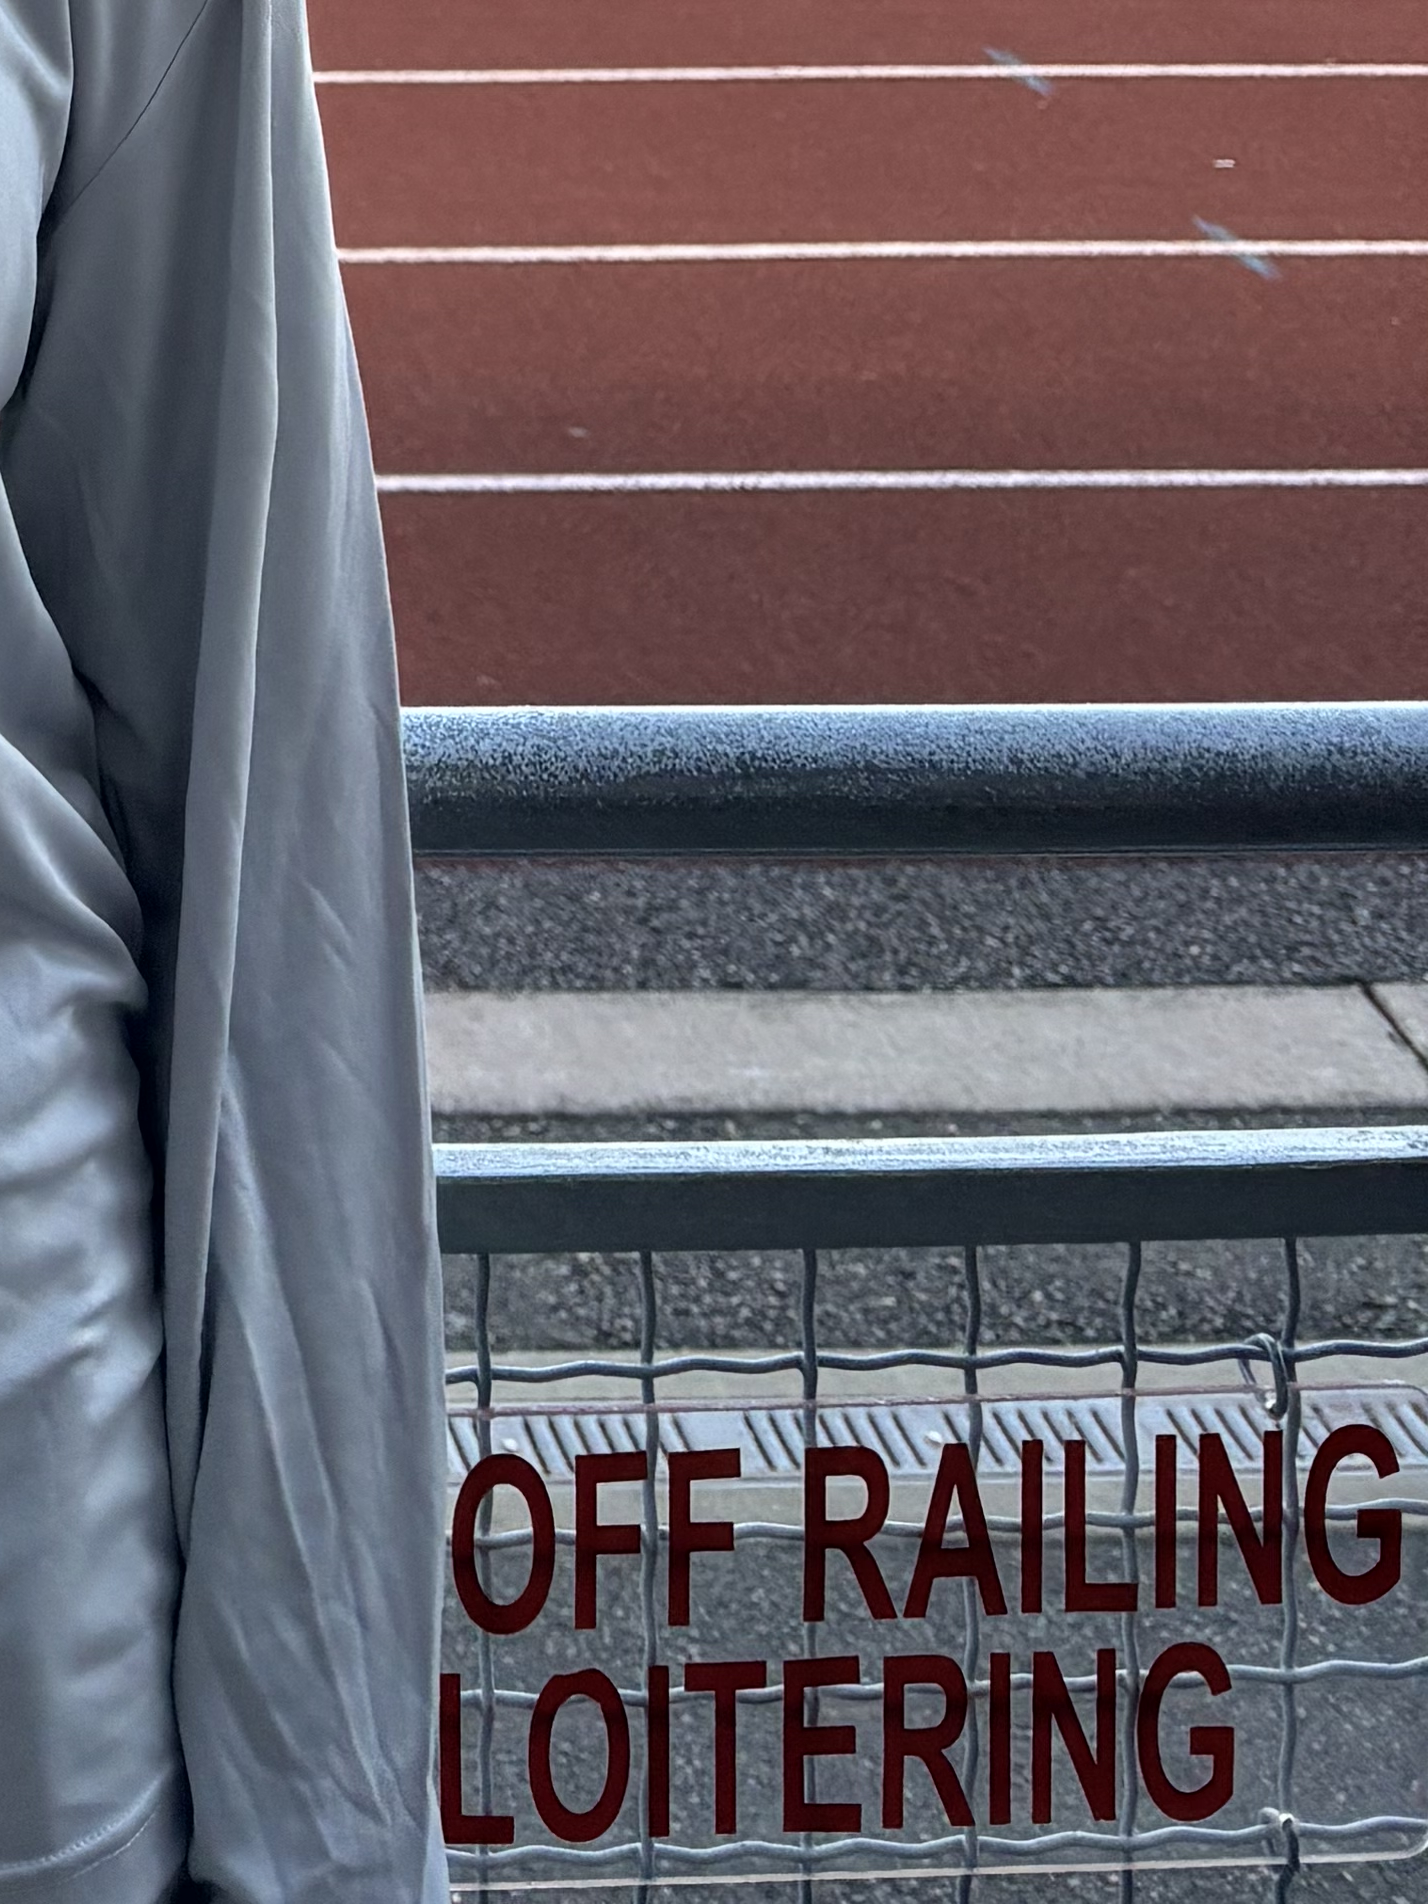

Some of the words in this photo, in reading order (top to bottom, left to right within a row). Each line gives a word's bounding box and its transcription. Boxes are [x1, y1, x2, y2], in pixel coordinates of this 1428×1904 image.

[451, 1448, 742, 1635] OFF
[801, 1423, 1402, 1623] RAILING
[439, 1641, 1236, 1845] LOITERING
